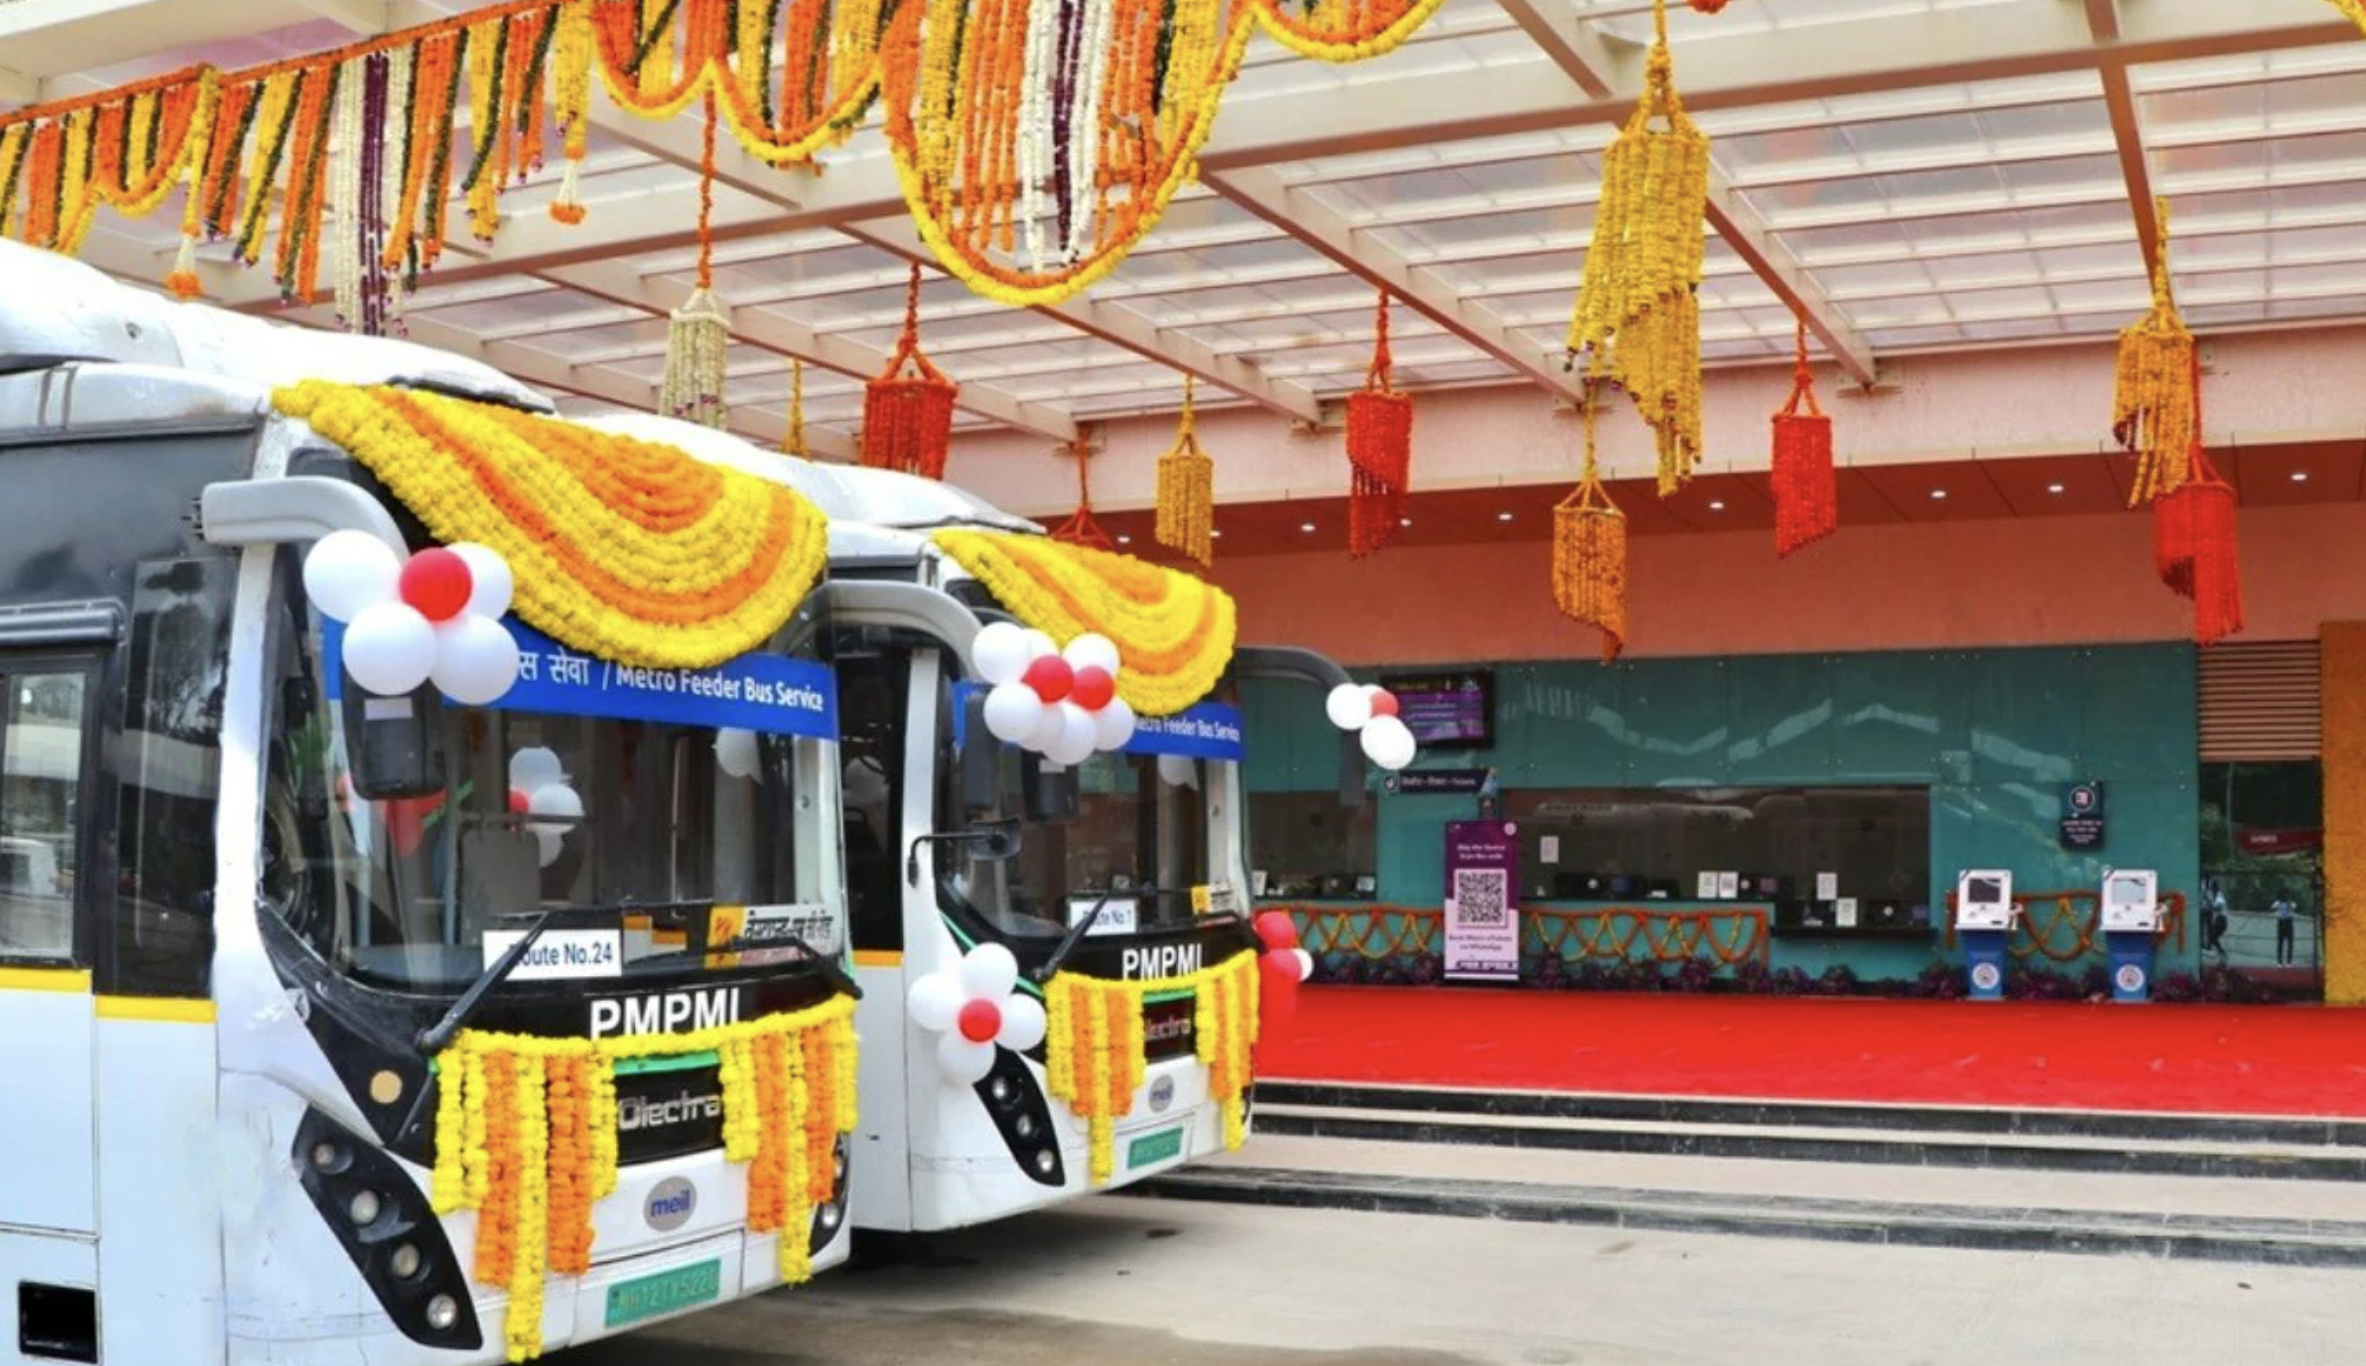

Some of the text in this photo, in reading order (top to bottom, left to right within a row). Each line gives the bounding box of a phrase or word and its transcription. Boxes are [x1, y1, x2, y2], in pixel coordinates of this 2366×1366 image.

[545, 645, 590, 686] सेवा
[616, 663, 677, 692] Metro
[680, 670, 741, 700] Feeder
[743, 676, 774, 705] Bus
[775, 681, 824, 712] Service
[1214, 721, 1241, 742] Service
[509, 942, 613, 967] oute No.24
[618, 1089, 721, 1131] Olectra
[651, 1190, 691, 1217] meil
